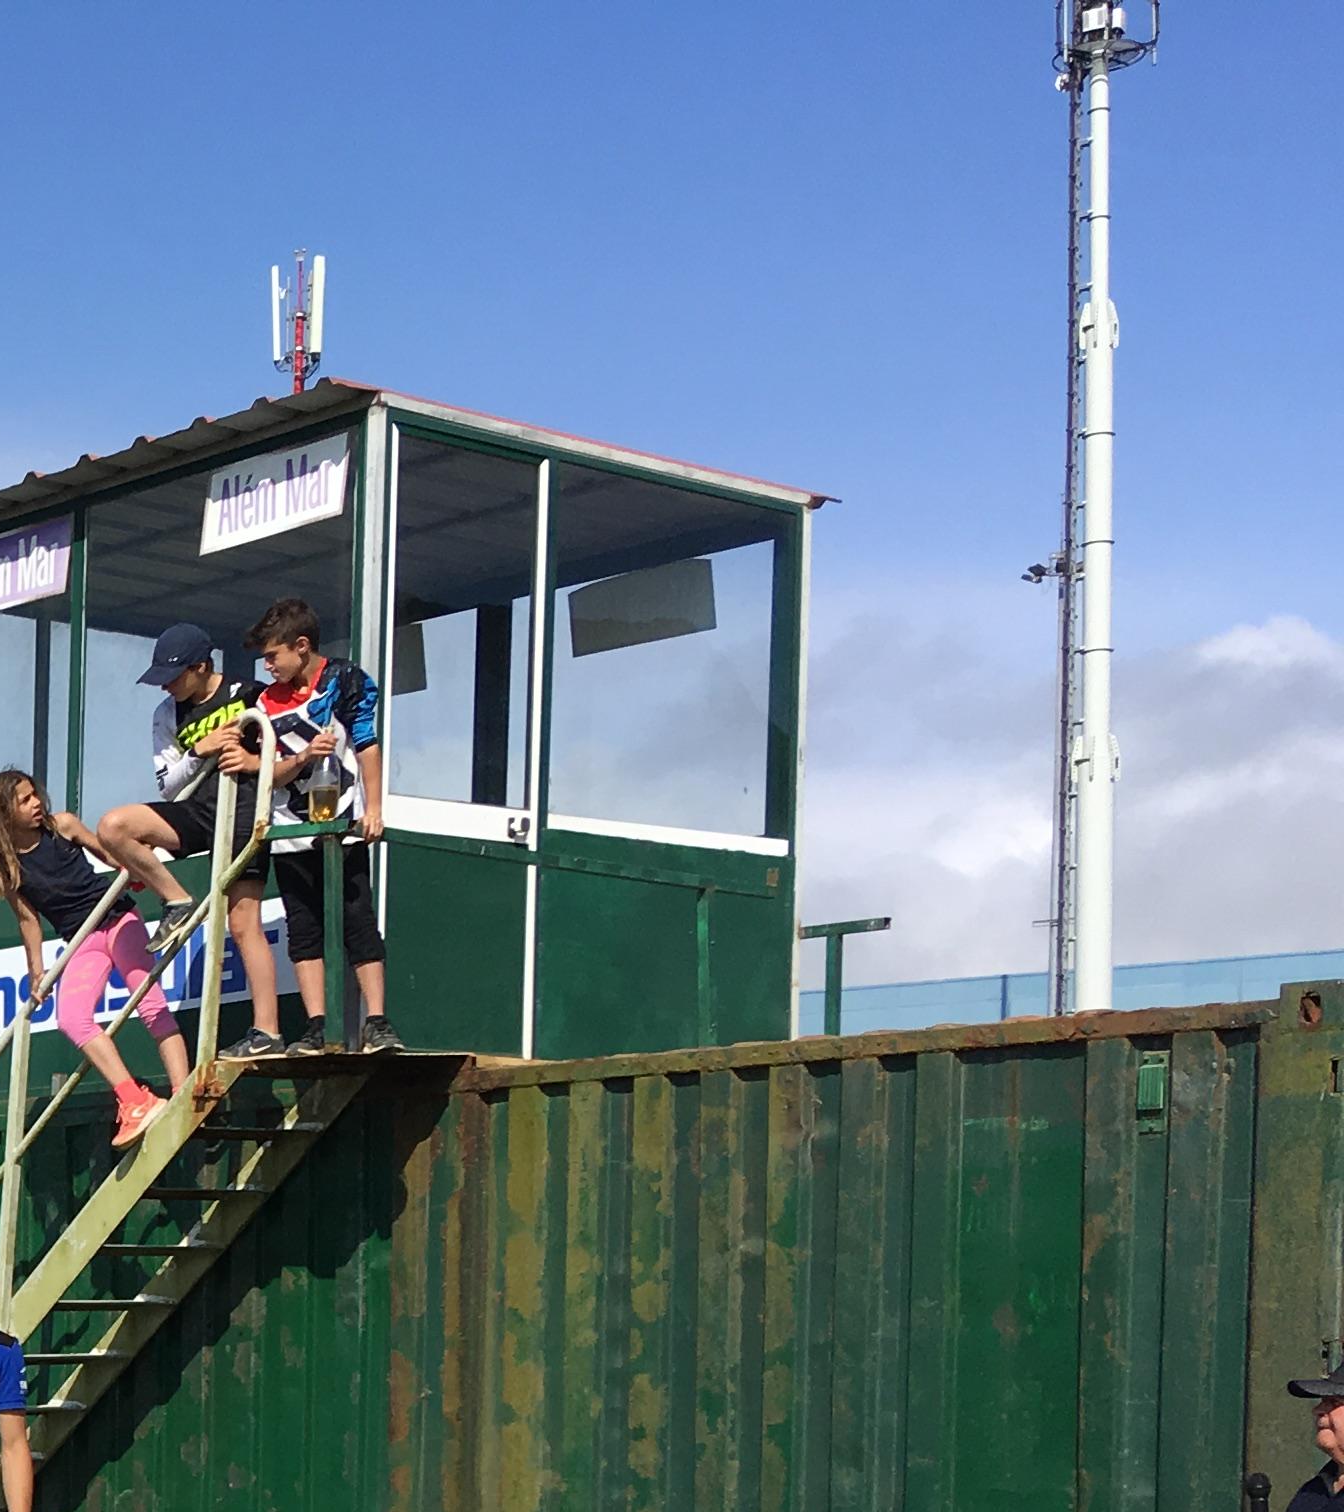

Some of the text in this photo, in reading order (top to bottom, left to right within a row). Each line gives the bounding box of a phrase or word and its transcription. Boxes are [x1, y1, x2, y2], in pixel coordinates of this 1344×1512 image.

[218, 453, 335, 536] Além Mar
[17, 534, 59, 592] Mar
